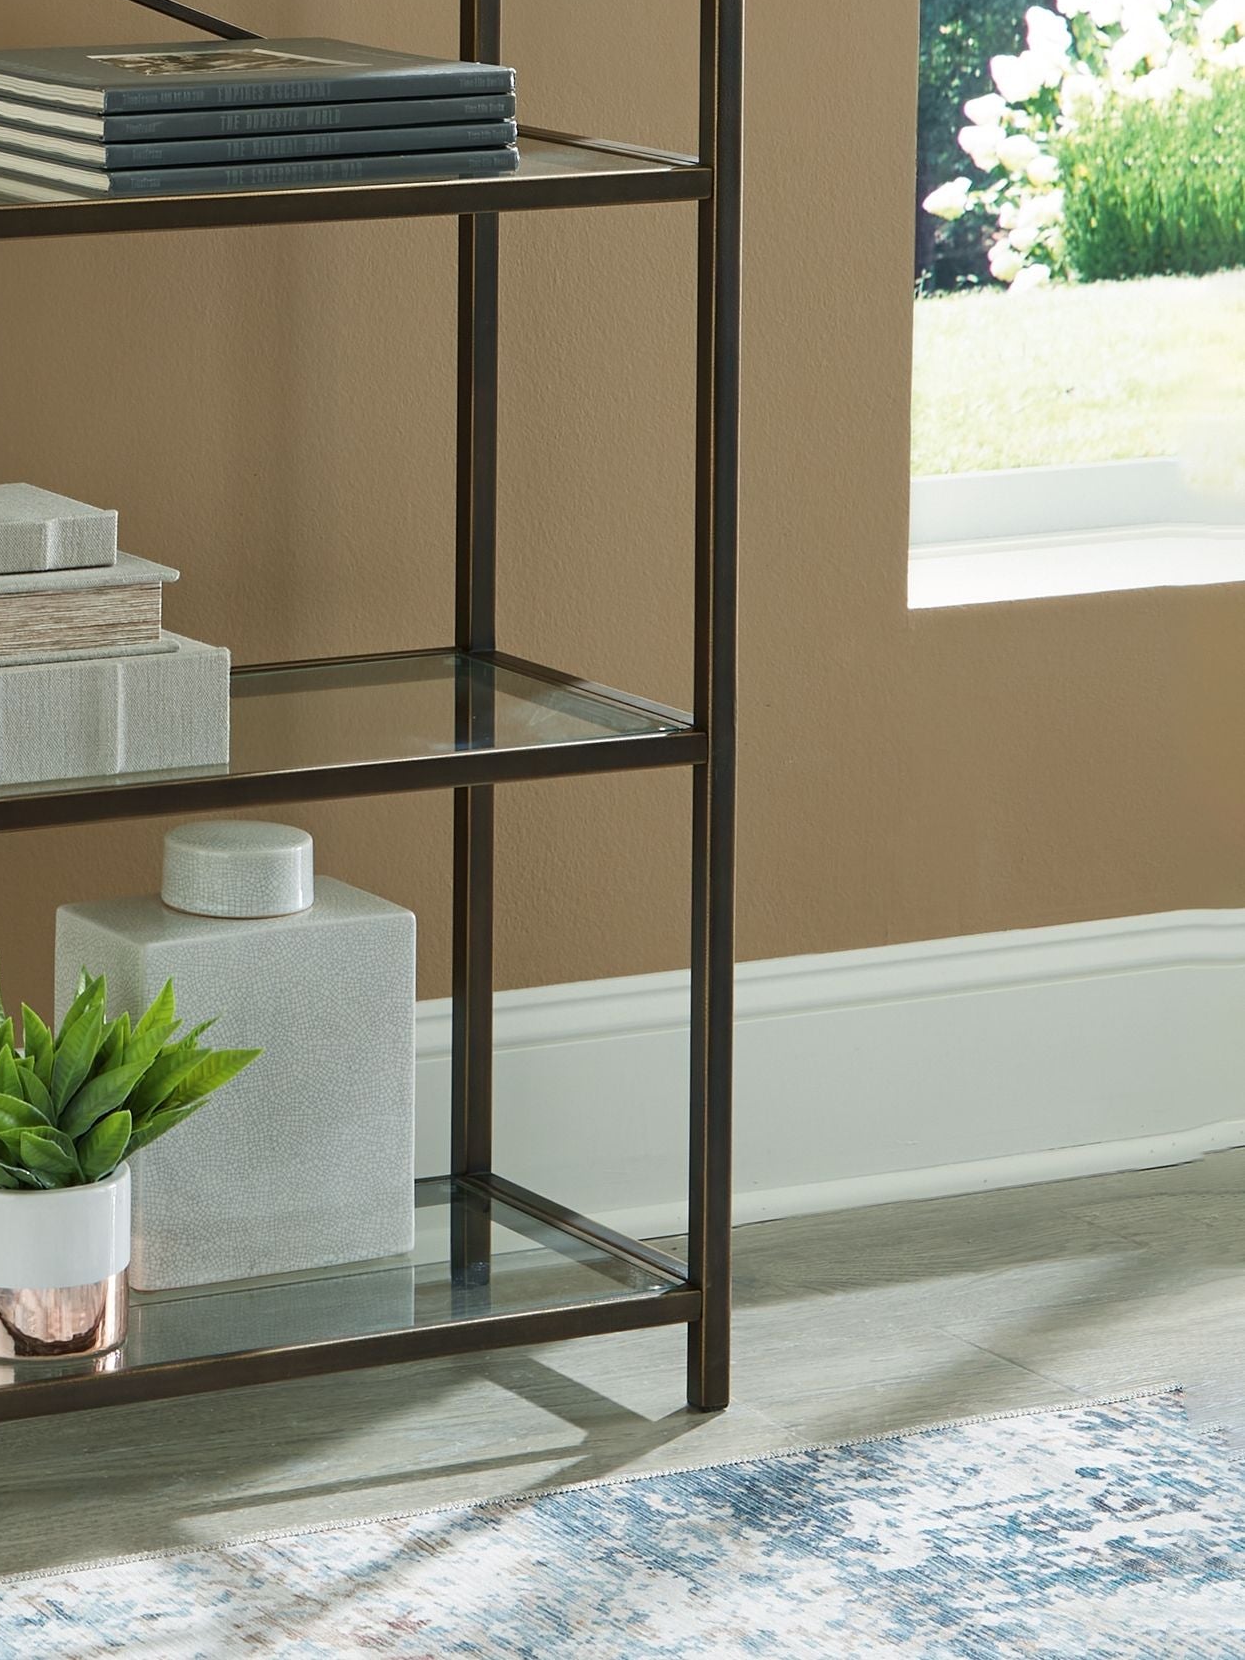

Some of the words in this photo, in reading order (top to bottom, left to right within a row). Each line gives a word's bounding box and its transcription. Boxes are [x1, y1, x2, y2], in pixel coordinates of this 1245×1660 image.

[219, 114, 240, 131] THE
[246, 110, 300, 130] DOMESTIC
[307, 108, 341, 126] WORLD
[227, 142, 245, 157] THE
[226, 169, 245, 185] THE
